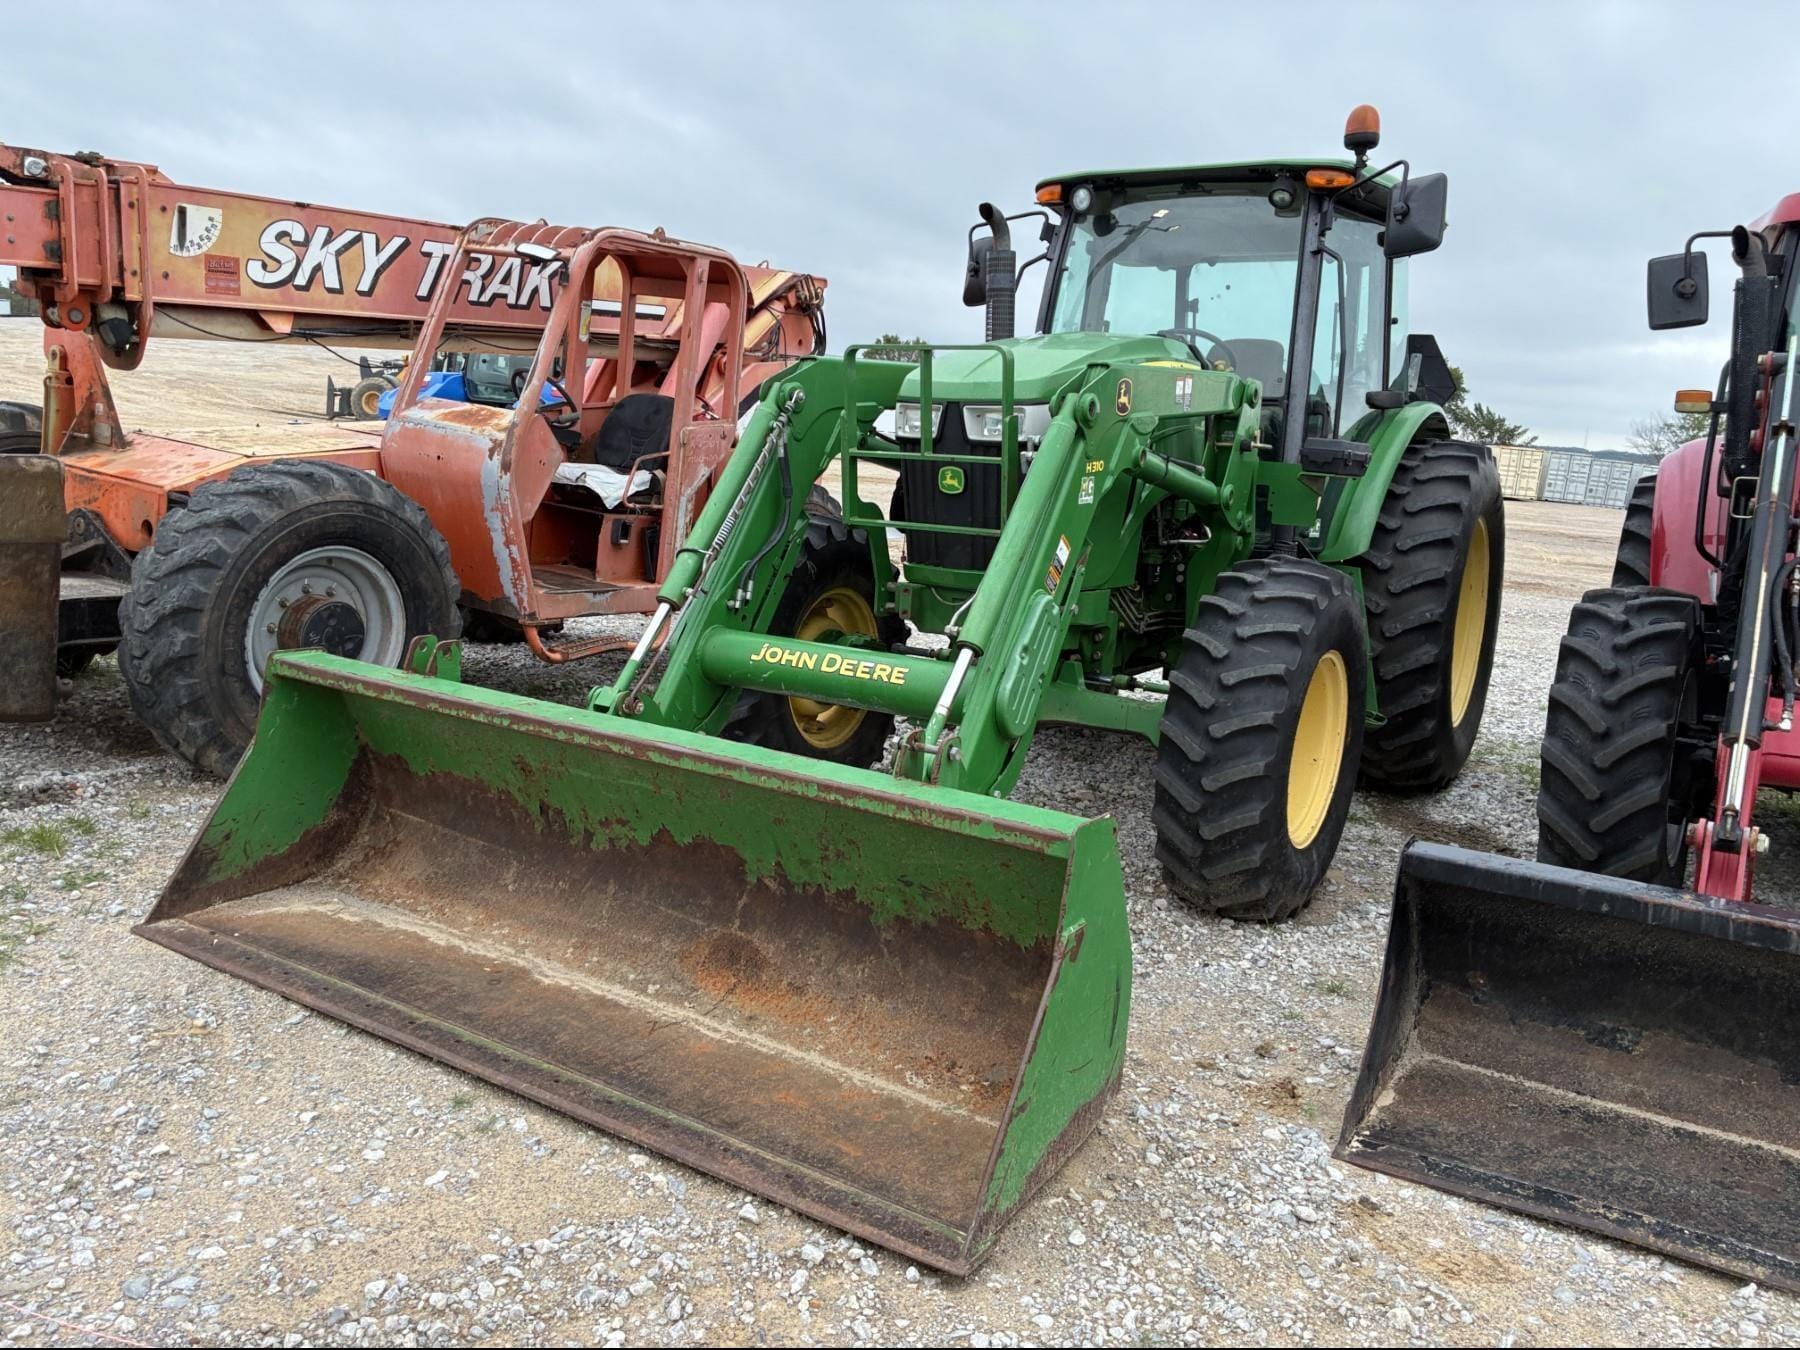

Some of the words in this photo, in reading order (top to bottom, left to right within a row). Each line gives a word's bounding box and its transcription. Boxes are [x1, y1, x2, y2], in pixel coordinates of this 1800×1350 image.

[246, 219, 410, 296] SKY
[415, 239, 564, 310] TRAK
[1086, 460, 1104, 473] H310
[751, 643, 816, 670] JOHN
[821, 653, 909, 685] DEERE
